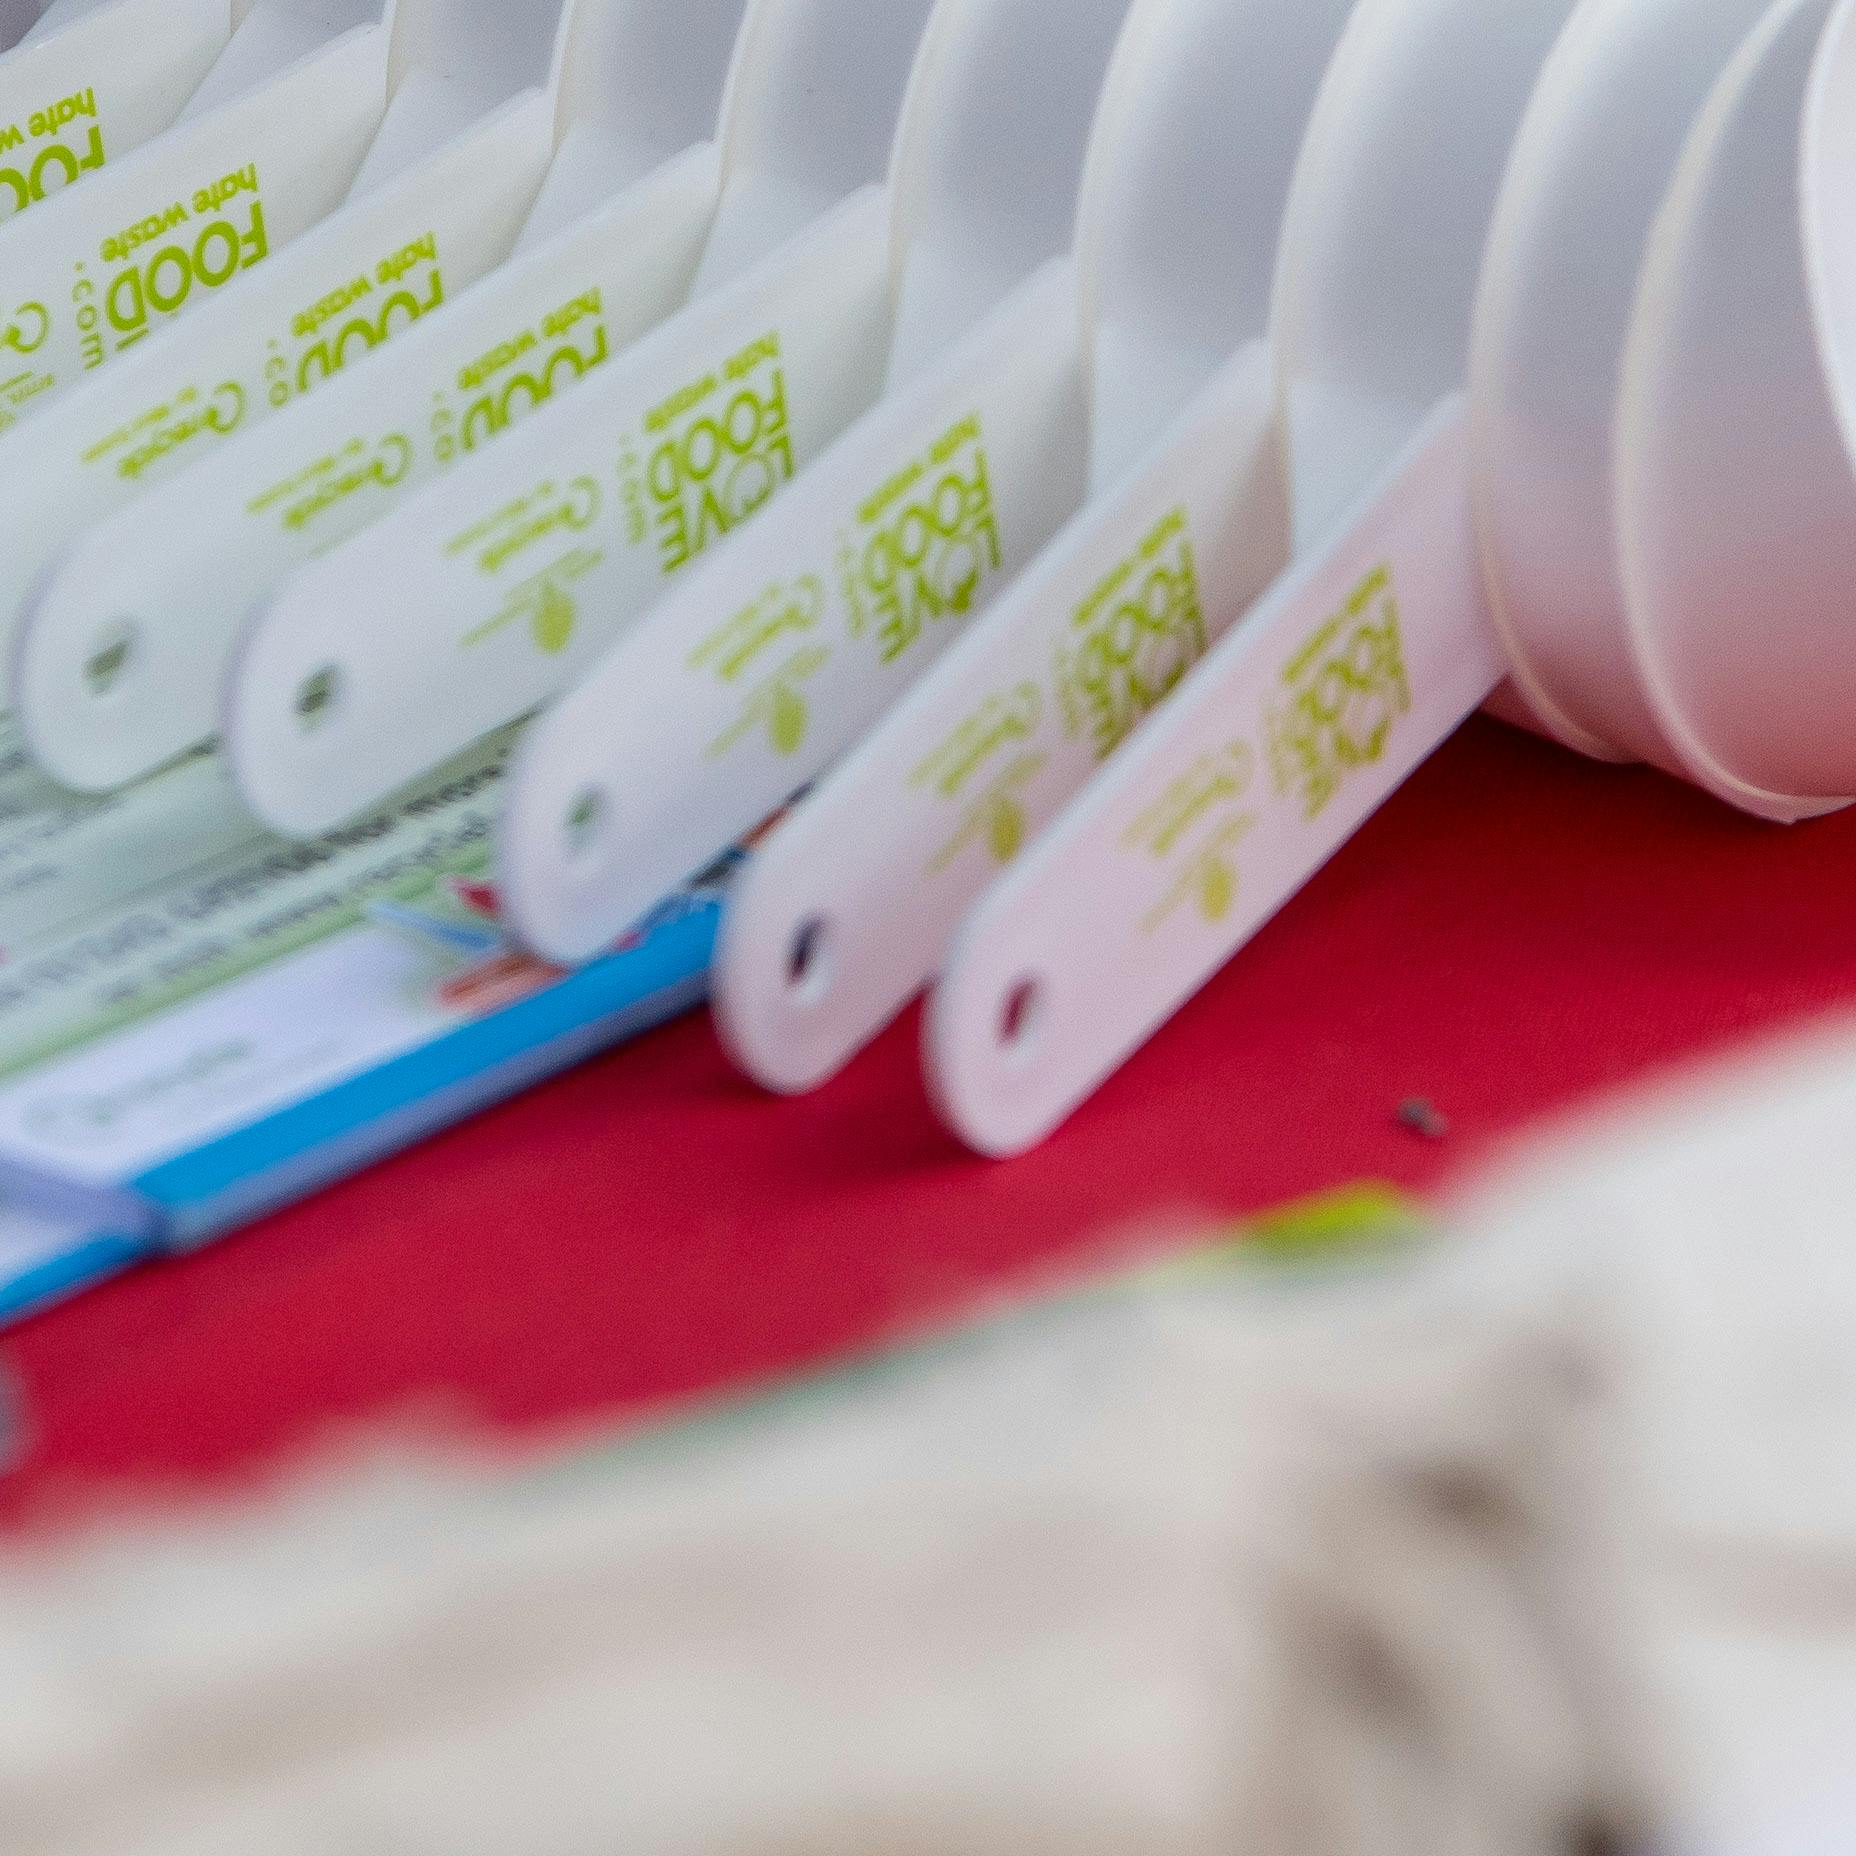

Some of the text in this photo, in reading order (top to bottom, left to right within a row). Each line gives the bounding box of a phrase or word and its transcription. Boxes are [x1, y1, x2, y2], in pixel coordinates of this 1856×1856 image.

[29, 86, 97, 139] hate
[101, 163, 259, 262] hate waste
[106, 200, 270, 331] FOOD
[291, 230, 438, 337] hate waste
[542, 286, 603, 339] hate
[647, 369, 788, 504] FOOD
[865, 449, 991, 593] FOOD
